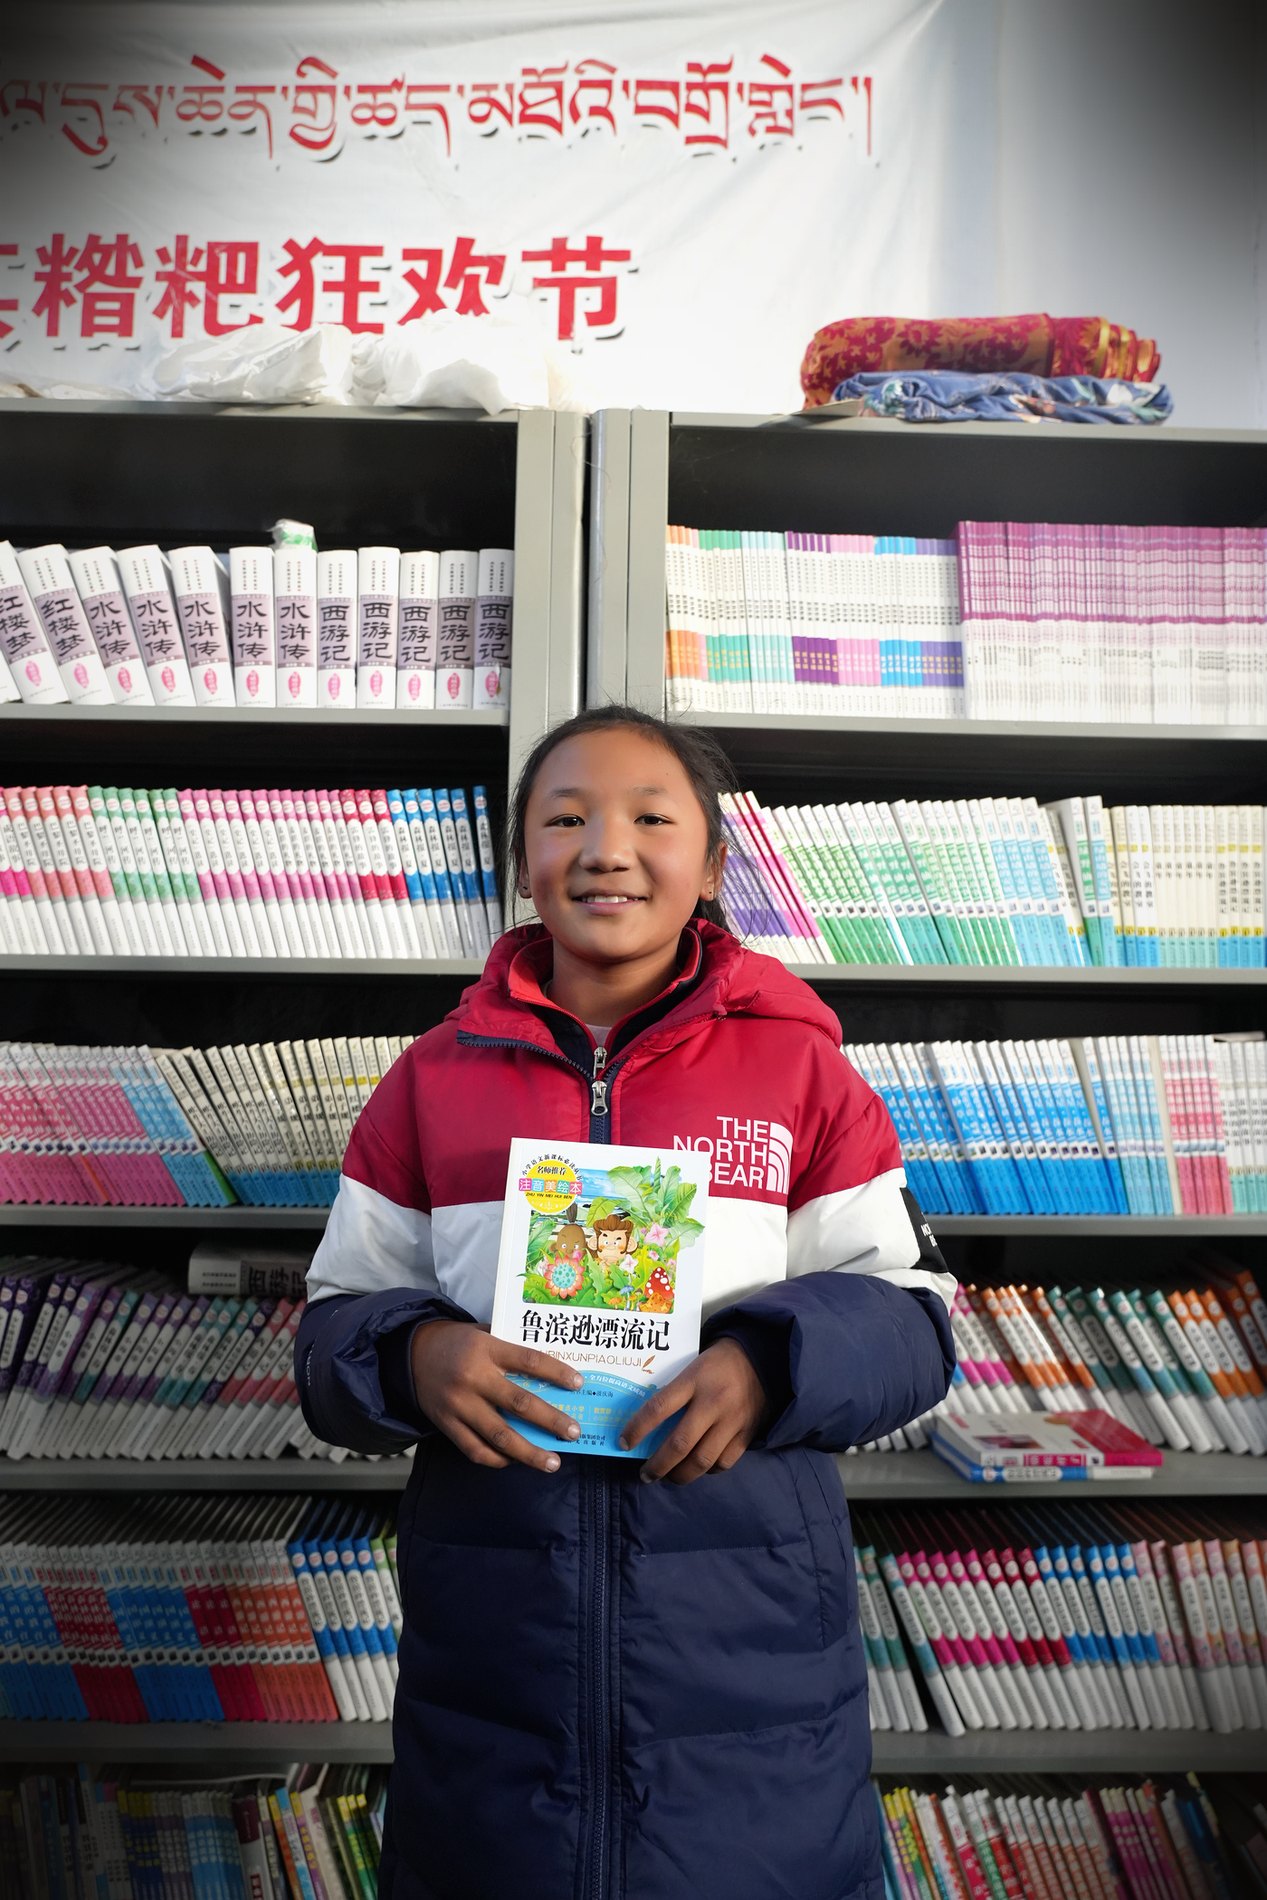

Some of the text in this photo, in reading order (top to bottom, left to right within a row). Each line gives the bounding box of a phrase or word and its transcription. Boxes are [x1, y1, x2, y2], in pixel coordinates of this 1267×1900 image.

[41, 597, 86, 657] 红楼梦
[90, 600, 131, 658] 水浒传
[136, 600, 177, 657] 水浒传
[184, 600, 221, 659] 水浒传
[236, 601, 269, 659] 水浒传
[280, 602, 312, 660] 水浒传
[320, 604, 351, 663] 西游记
[362, 602, 394, 660] 西游记
[401, 605, 432, 663] 西游记
[440, 604, 472, 663] 西游记
[478, 603, 511, 661] 西游记
[673, 1135, 768, 1167] NORTH
[716, 1115, 769, 1143] THE
[519, 1178, 583, 1195] 注音美绘本
[537, 1165, 567, 1176] 名师推荐
[520, 1310, 670, 1351] 鲁滨逊漂流记
[541, 1350, 642, 1367] BINXUNPIAOLIUJI
